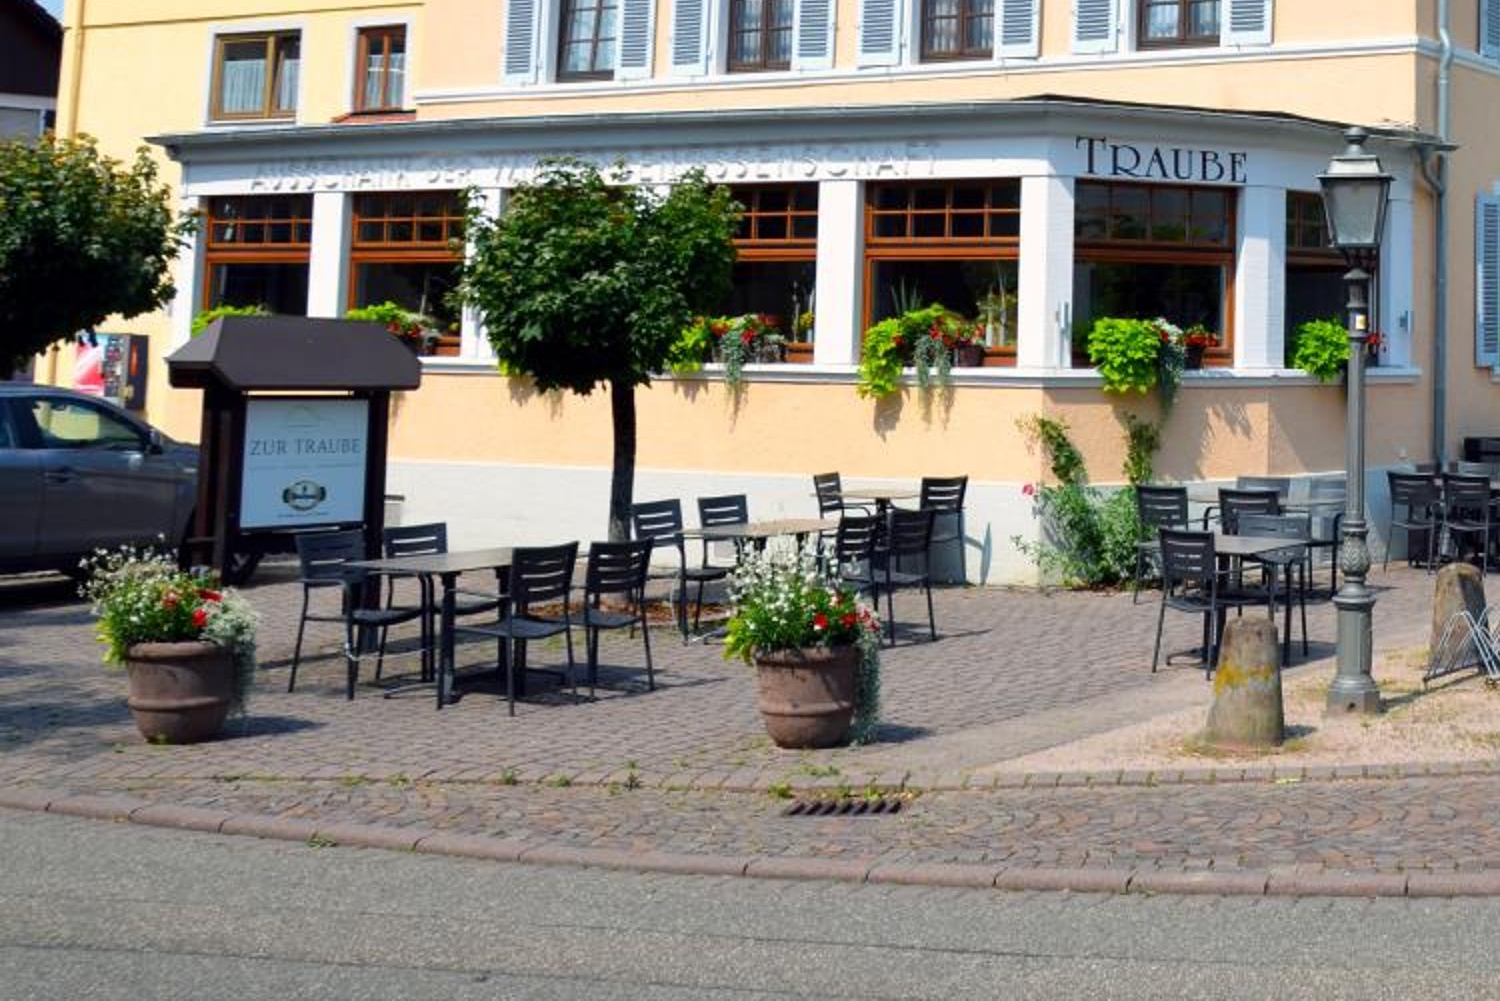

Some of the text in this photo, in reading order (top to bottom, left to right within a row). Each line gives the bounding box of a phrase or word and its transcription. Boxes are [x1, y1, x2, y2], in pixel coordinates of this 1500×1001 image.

[1075, 135, 1247, 183] TRAUBE
[249, 437, 361, 456] ZUR TRAUBE
